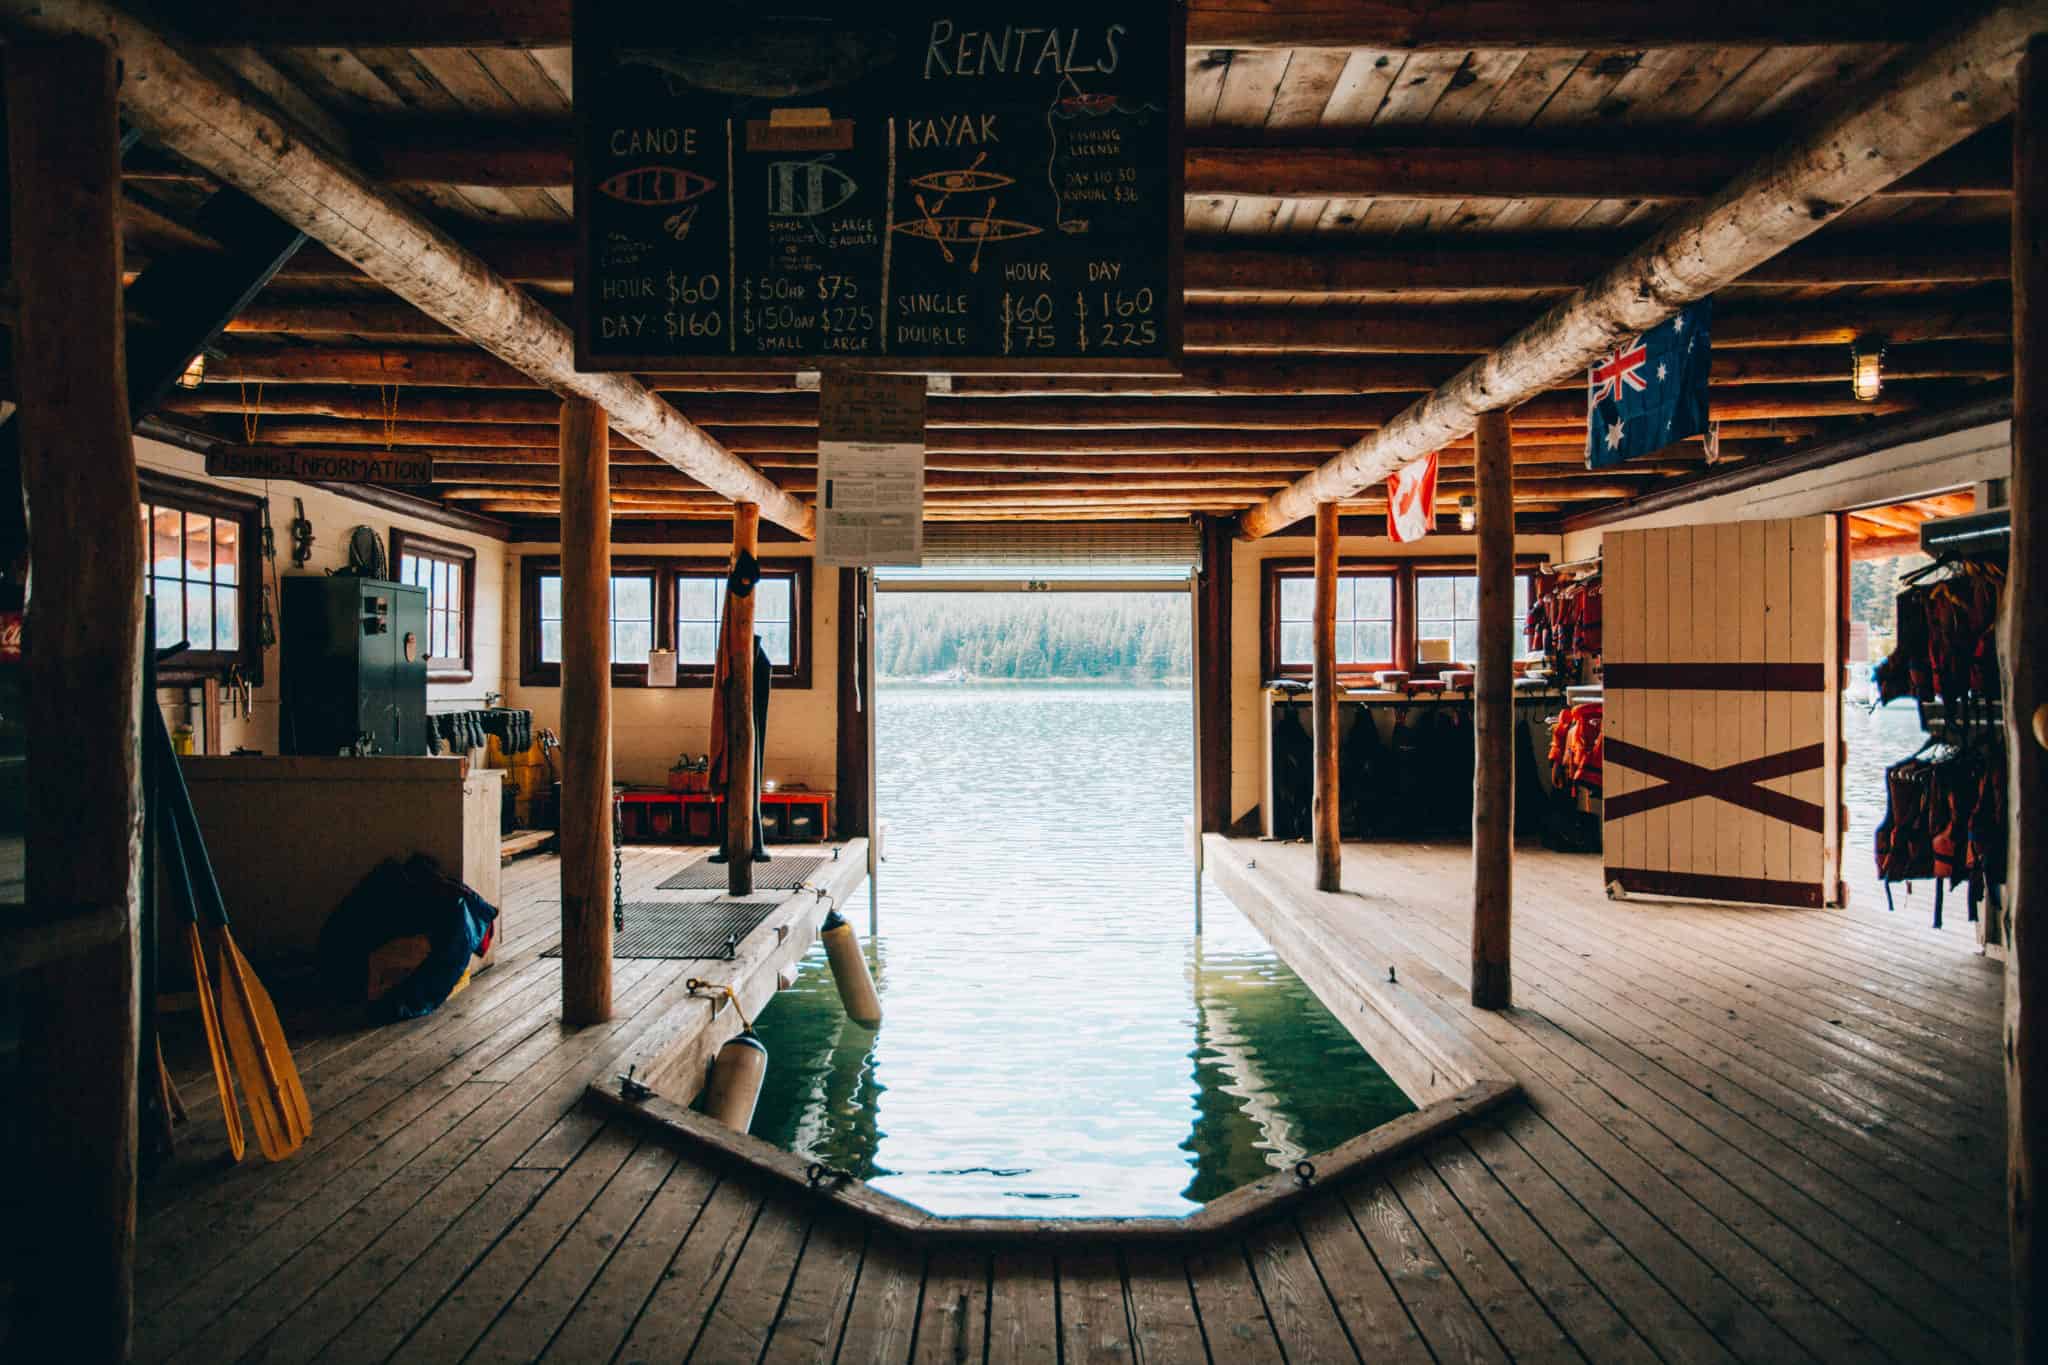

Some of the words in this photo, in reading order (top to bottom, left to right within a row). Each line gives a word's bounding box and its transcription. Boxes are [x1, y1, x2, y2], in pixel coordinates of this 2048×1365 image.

[923, 18, 1128, 80] RENTALS
[609, 128, 698, 156] CANOE
[907, 113, 1000, 150] KAYAK
[1004, 262, 1053, 281] HOUR
[1088, 262, 1121, 282] DAY
[602, 277, 657, 299] HOUR
[664, 270, 721, 305] $60
[817, 274, 857, 300] $75
[897, 293, 969, 315] SINGLE
[664, 311, 721, 341] $160
[822, 304, 874, 335] $225
[757, 335, 806, 351] SMALL
[823, 335, 869, 351] LARGE
[897, 325, 969, 346] DOUBLE
[286, 451, 427, 481] INFORMATION
